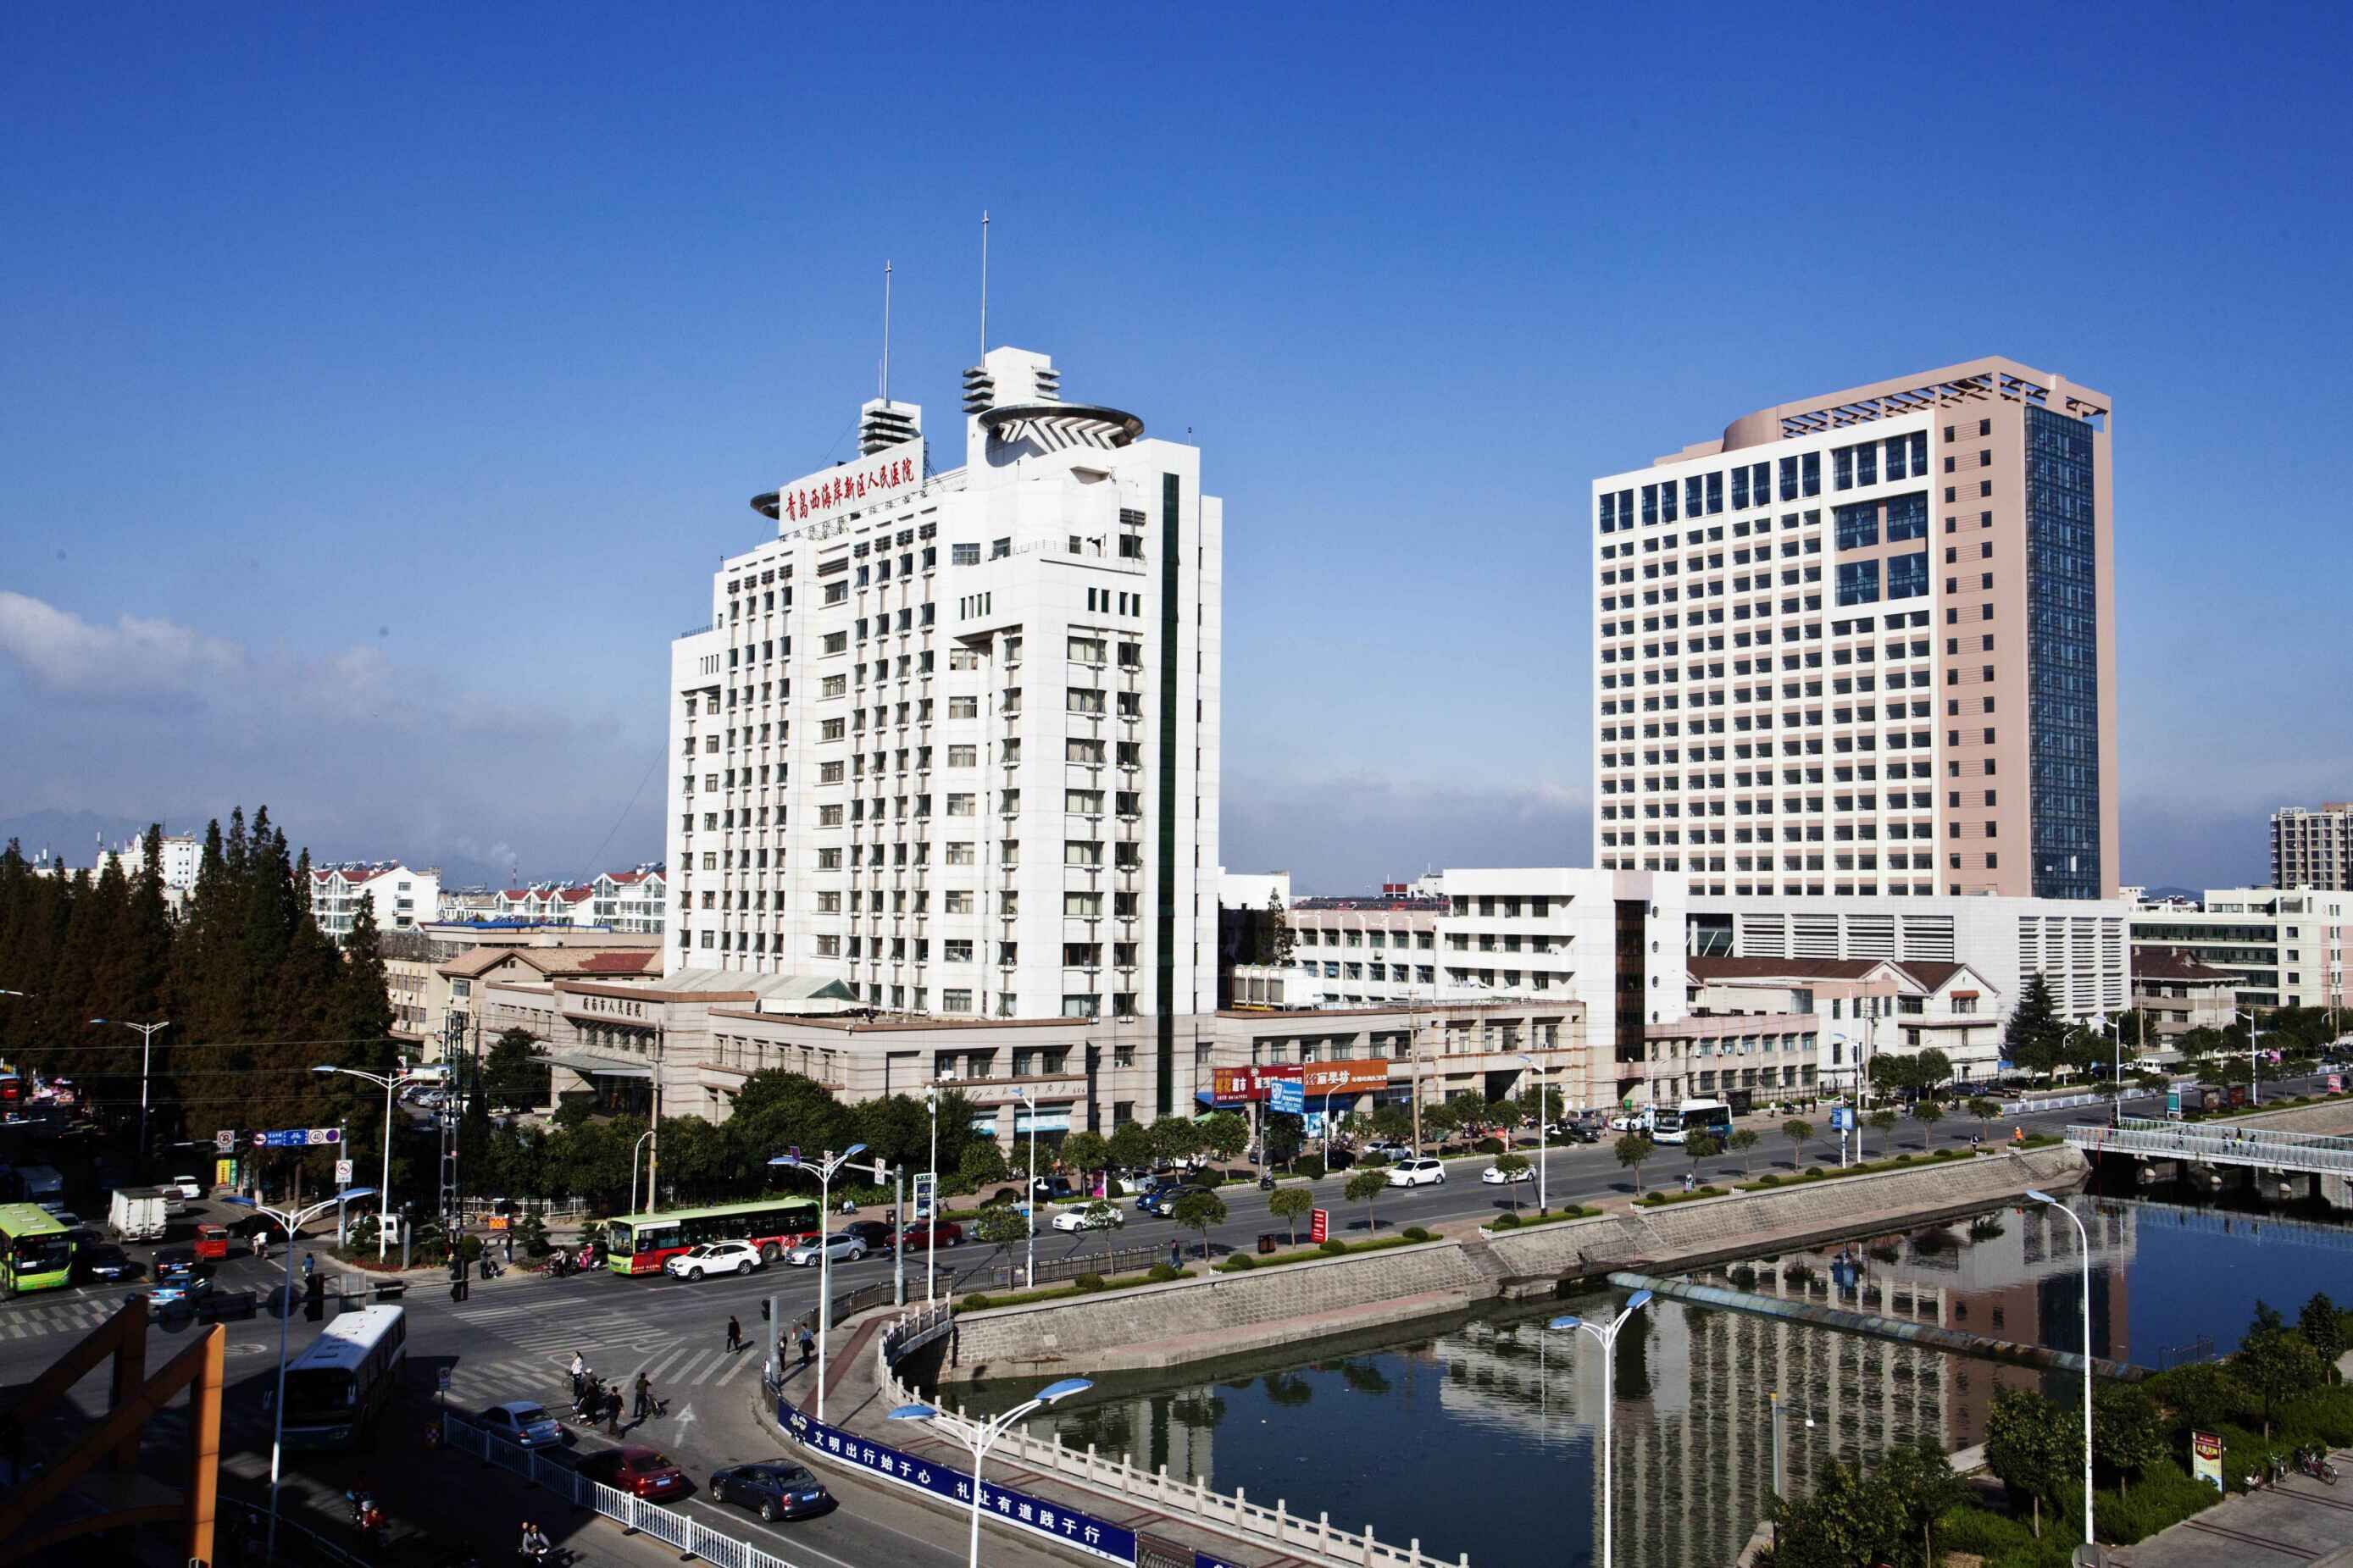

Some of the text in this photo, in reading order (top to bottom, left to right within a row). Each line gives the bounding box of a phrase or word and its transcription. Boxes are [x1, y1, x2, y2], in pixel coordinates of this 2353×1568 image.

[785, 457, 914, 522] 青岛西海岸新区人民医院
[583, 996, 641, 1017] 胶南市人民医院
[814, 1430, 1100, 1543] 文明出行始于心 礼让有道践于行
